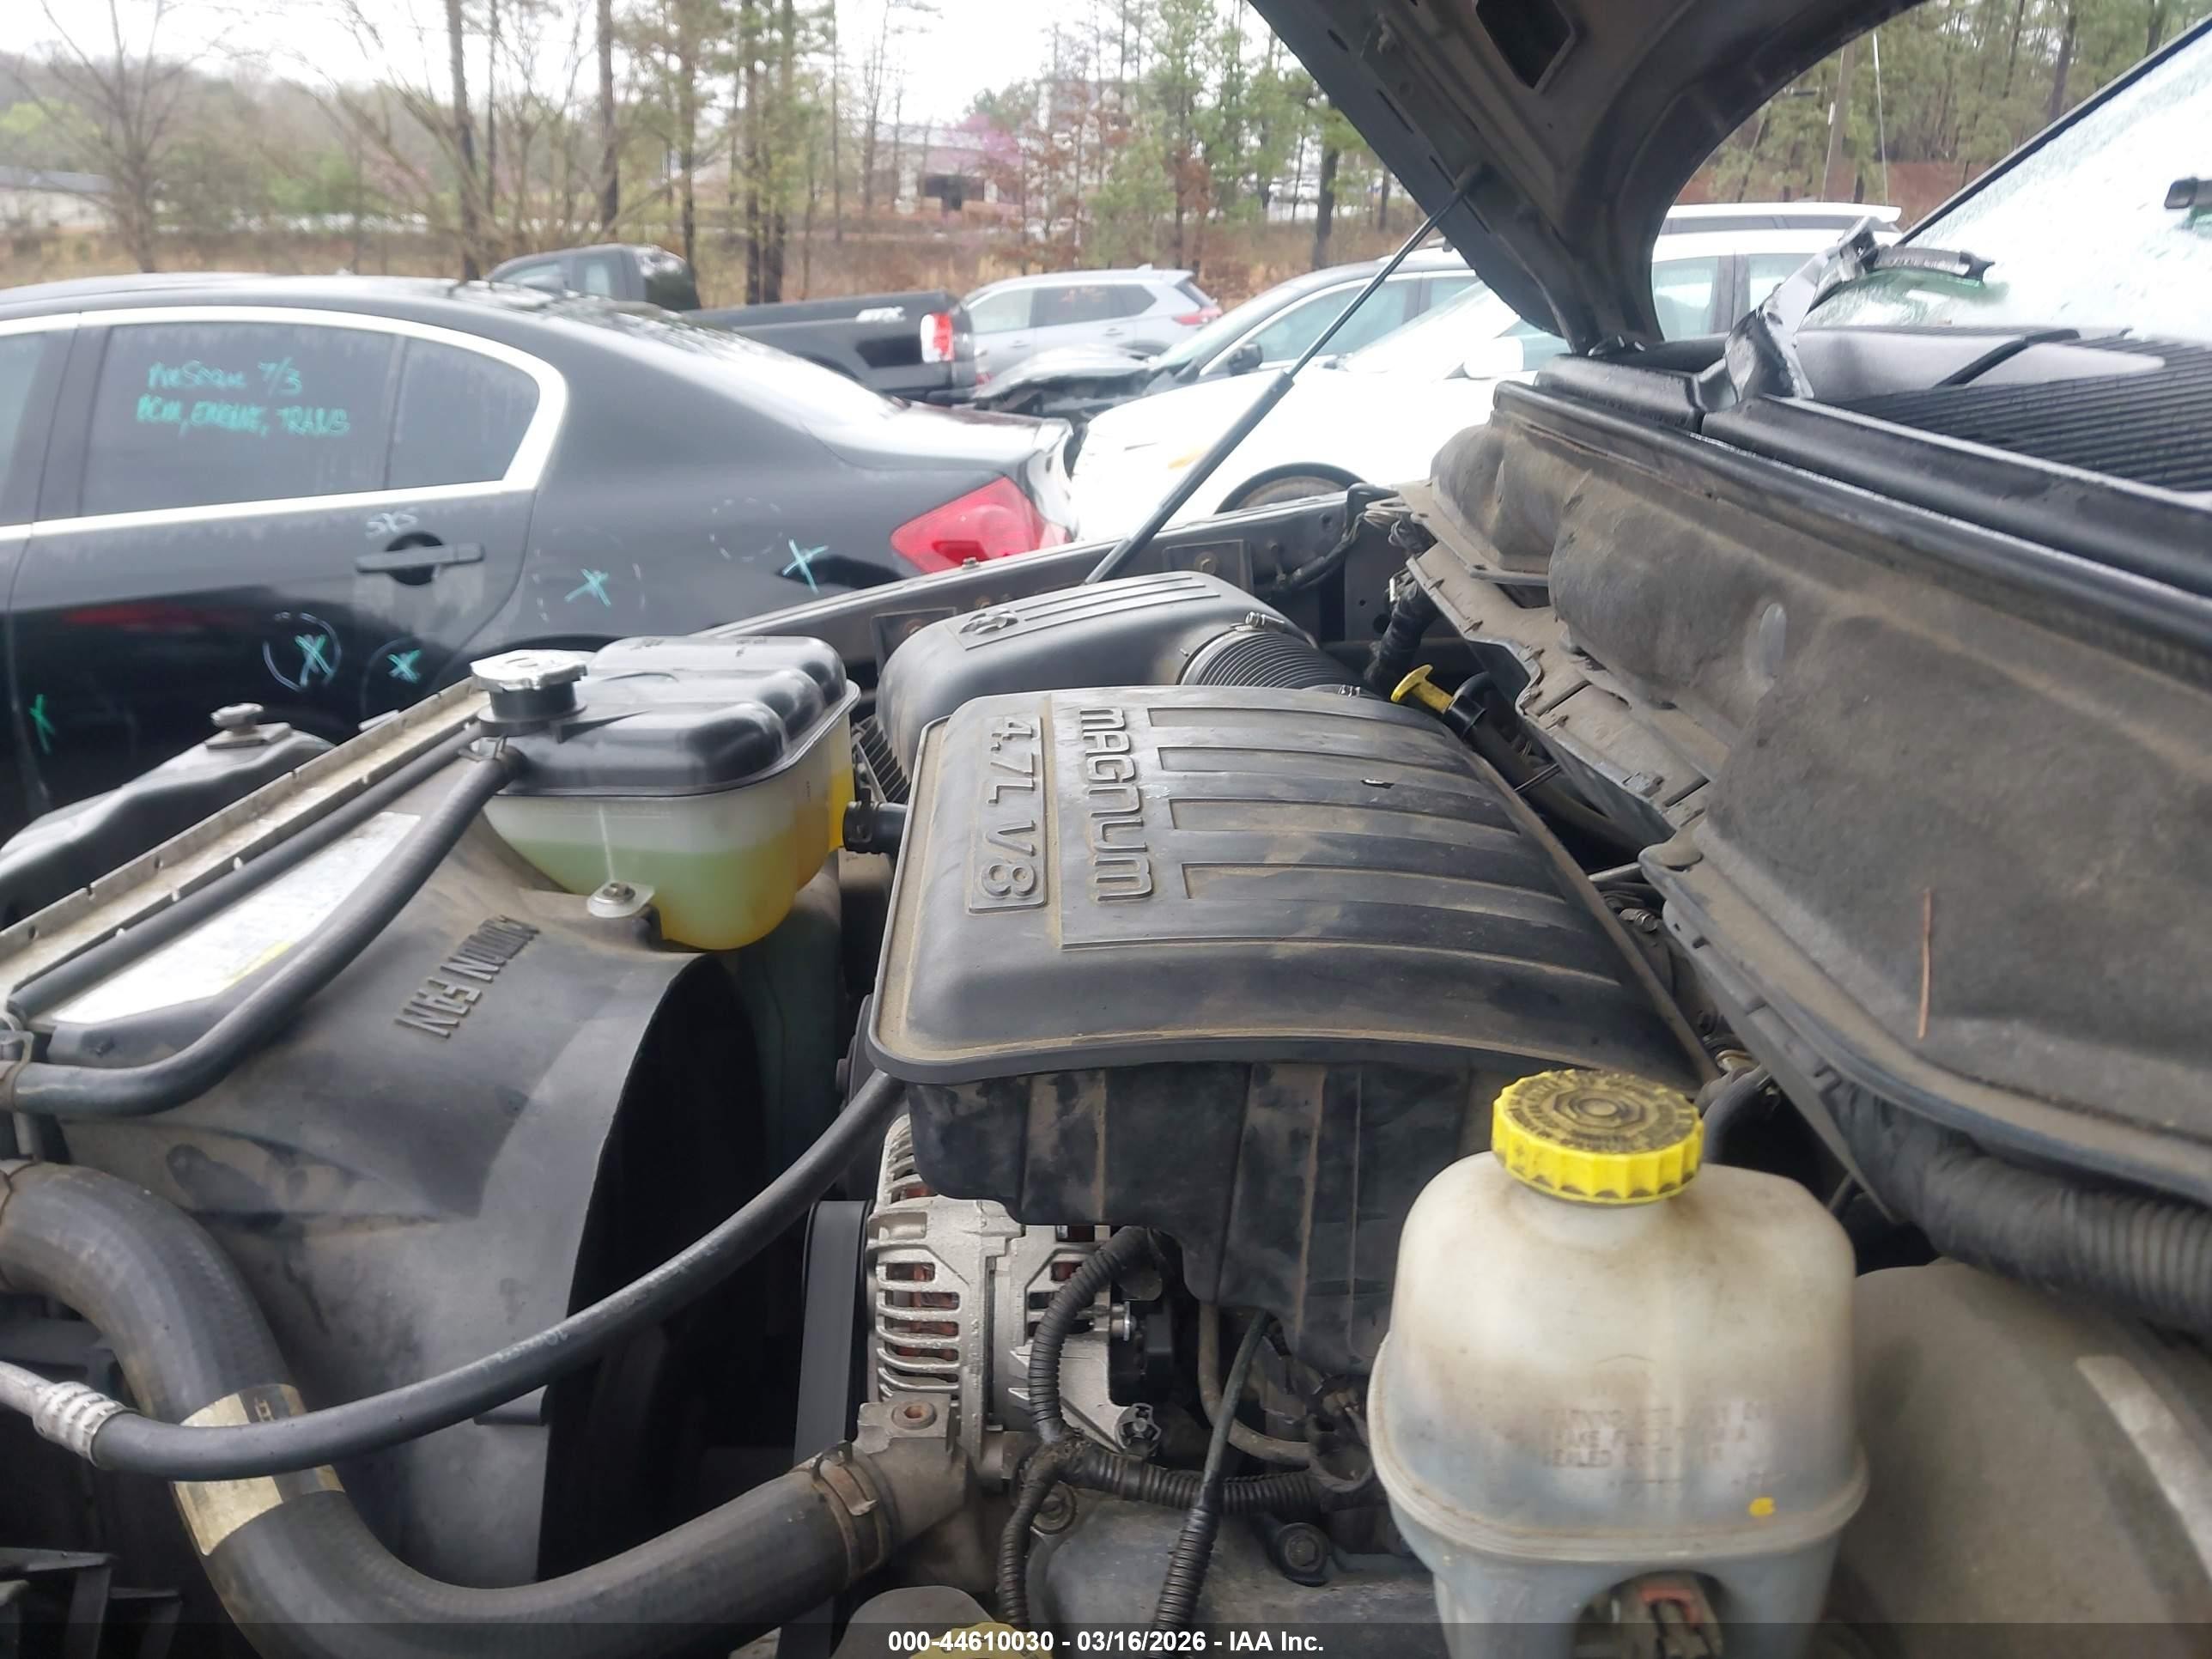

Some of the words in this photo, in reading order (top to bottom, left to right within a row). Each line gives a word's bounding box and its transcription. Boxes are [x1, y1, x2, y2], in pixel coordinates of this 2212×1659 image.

[987, 720, 1035, 805] 4.7L
[981, 820, 1037, 897] V8
[394, 975, 483, 1039] FAN
